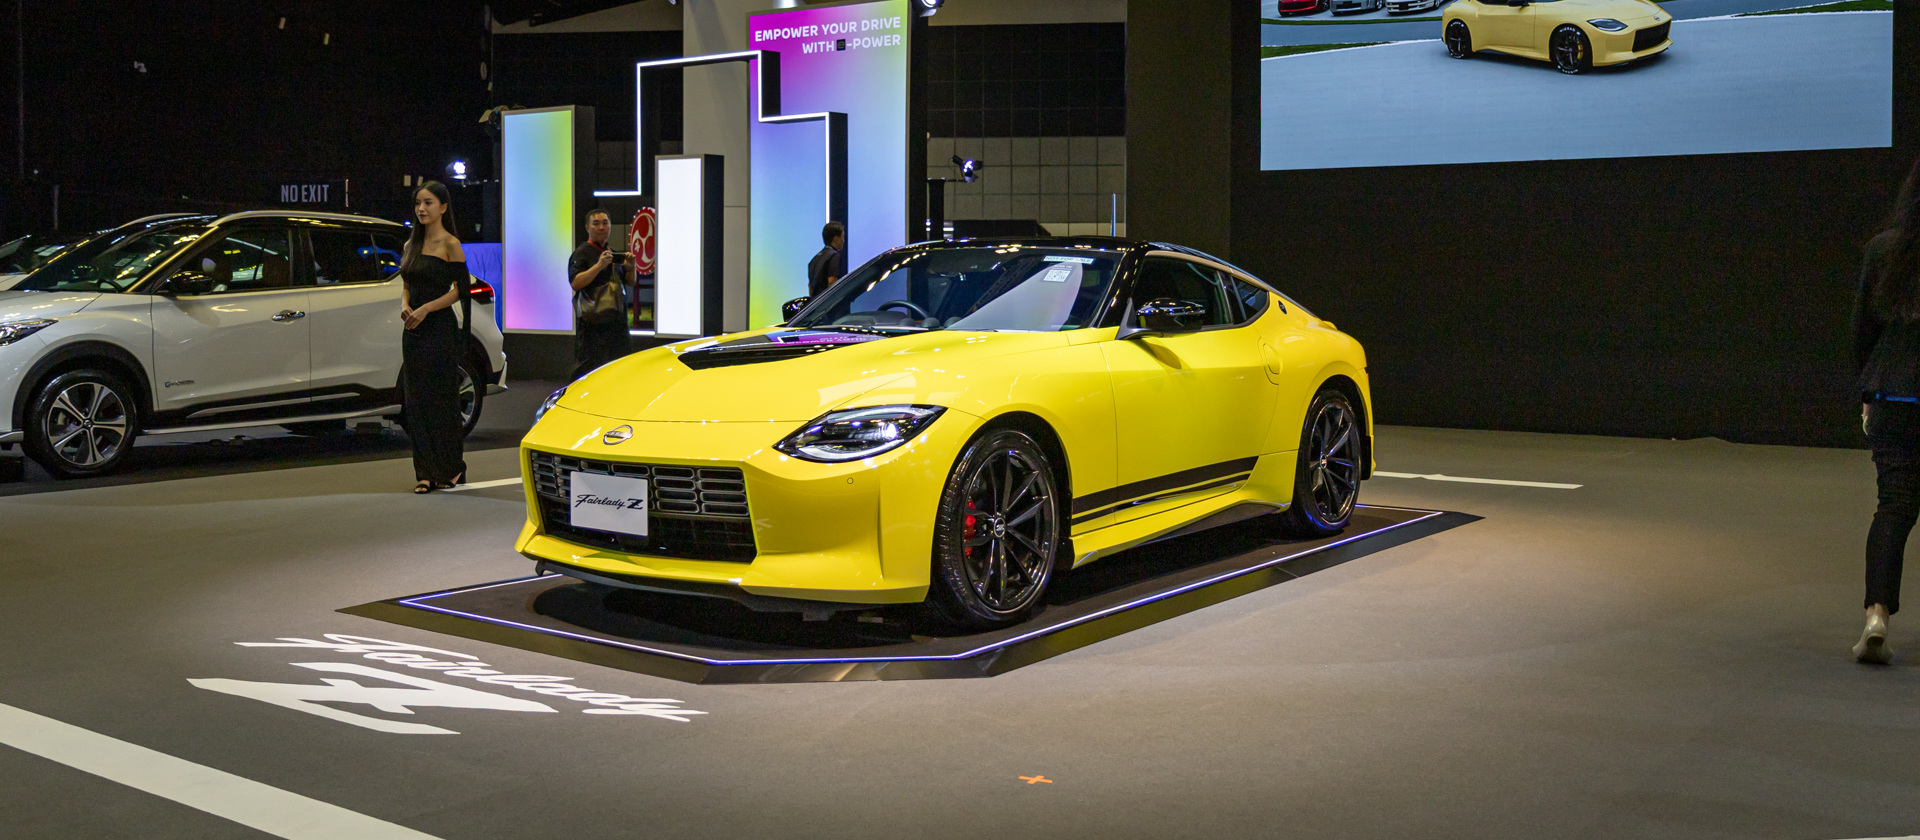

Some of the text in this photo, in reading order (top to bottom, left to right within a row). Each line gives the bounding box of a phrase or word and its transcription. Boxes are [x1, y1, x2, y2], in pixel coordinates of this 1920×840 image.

[755, 16, 901, 42] EMPOWER YOUR DRIVE
[802, 41, 834, 54] WITH
[281, 184, 330, 203] NO EXIT
[574, 494, 644, 510] Fairlady Z
[233, 634, 709, 722] Fairlady
[186, 662, 559, 735] Z
